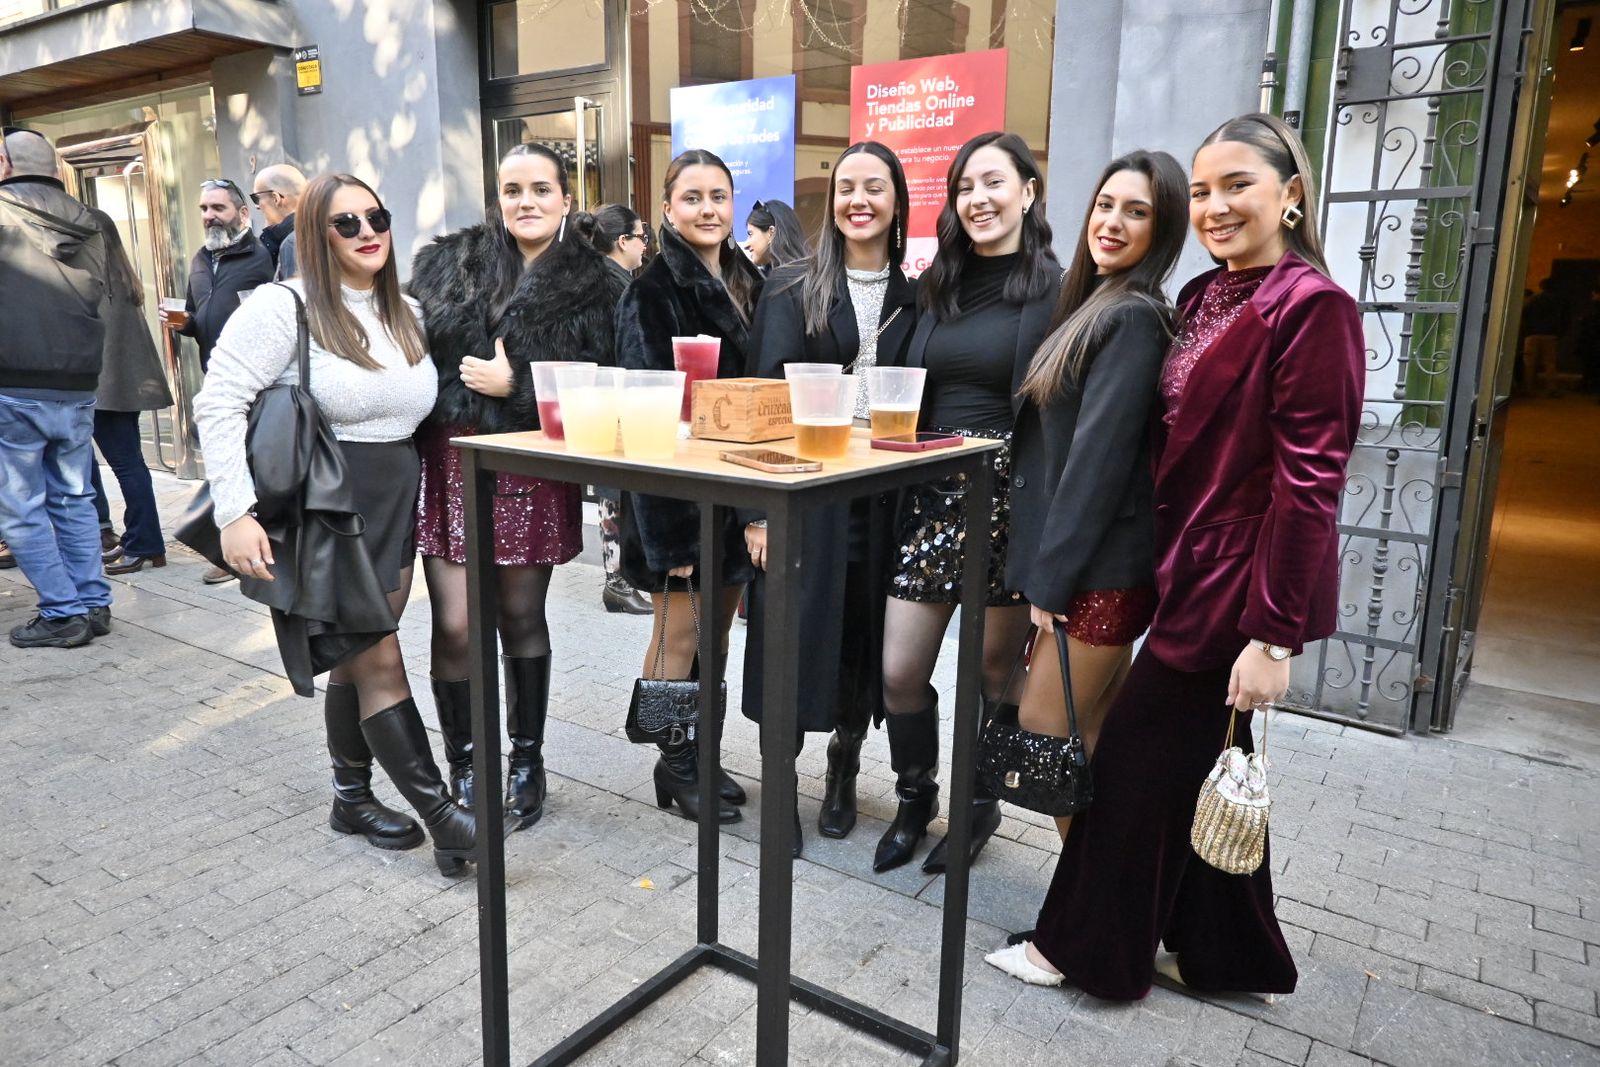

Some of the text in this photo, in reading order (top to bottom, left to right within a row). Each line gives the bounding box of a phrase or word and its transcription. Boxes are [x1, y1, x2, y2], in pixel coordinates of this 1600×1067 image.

[866, 76, 960, 99] Diseño Web,
[866, 93, 975, 116] Tiendas Online
[746, 128, 781, 144] redes
[865, 112, 955, 137] y Publicidad
[900, 146, 932, 154] establece
[922, 153, 951, 163] negocio.
[712, 394, 732, 431] C
